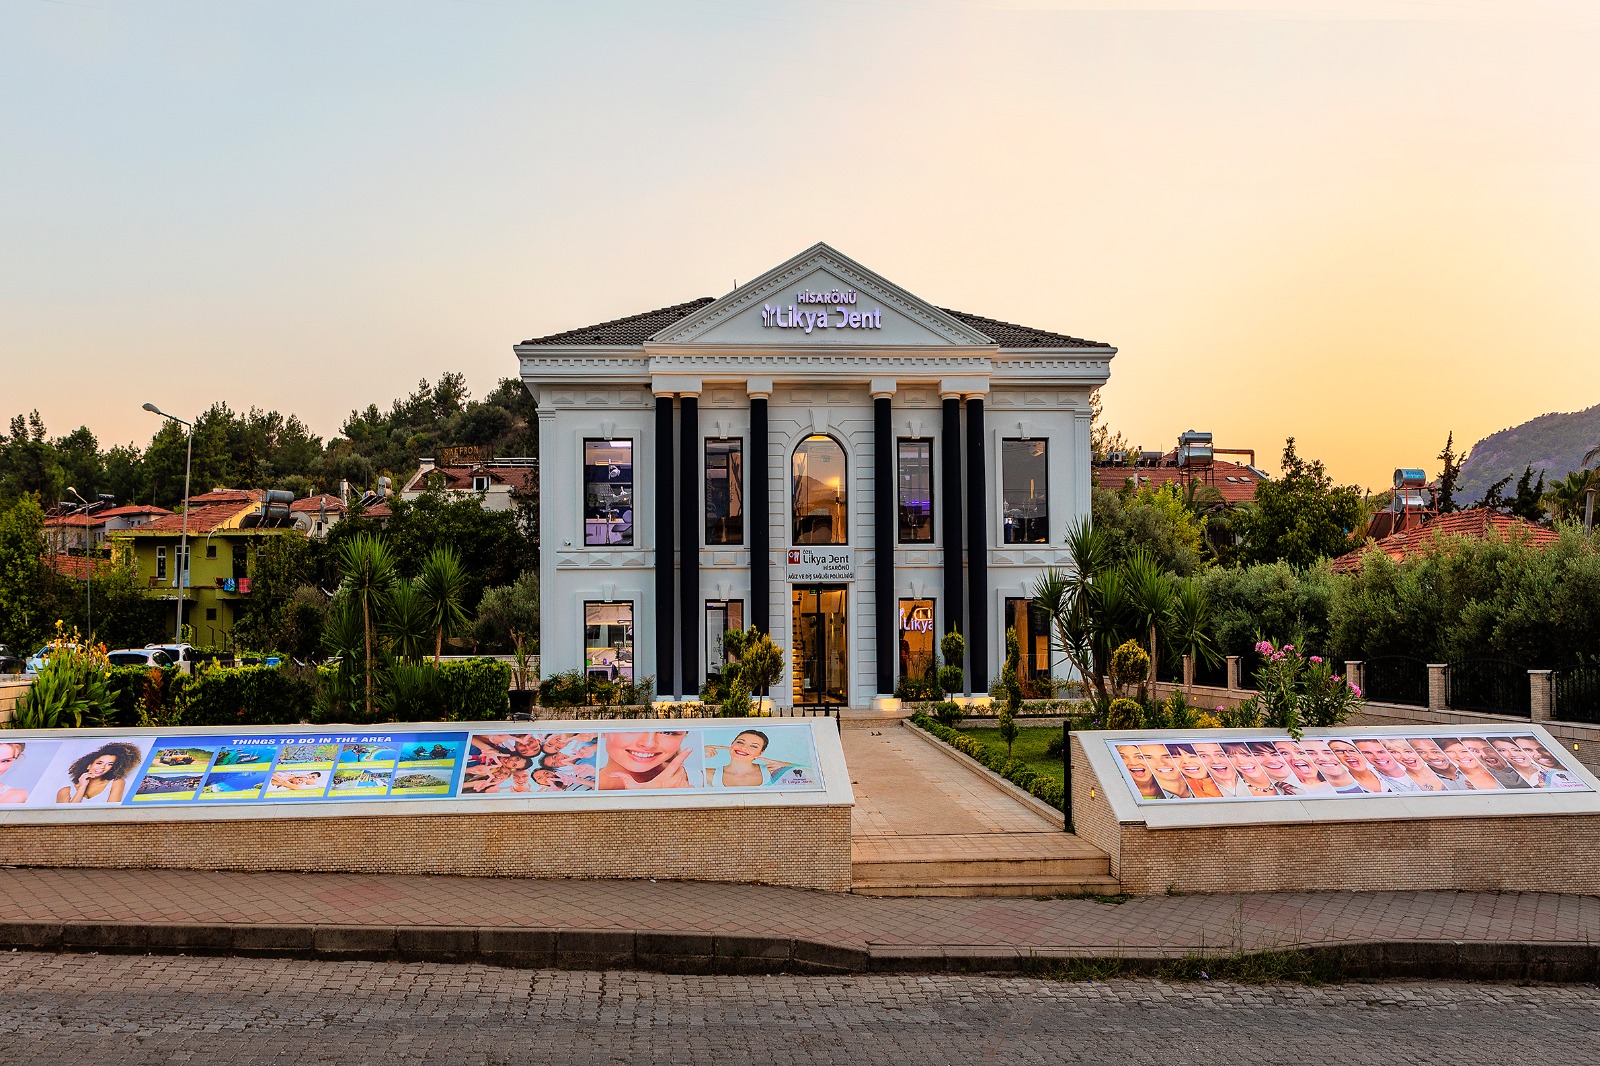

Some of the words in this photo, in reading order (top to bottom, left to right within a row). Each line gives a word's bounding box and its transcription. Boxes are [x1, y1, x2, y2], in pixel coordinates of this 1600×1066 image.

[797, 289, 857, 304] HİSARÖNÜ
[776, 305, 829, 334] Likya
[836, 306, 882, 329] Dent
[444, 446, 479, 456] SAFFRON
[803, 555, 826, 565] Likya
[829, 555, 849, 563] Dent
